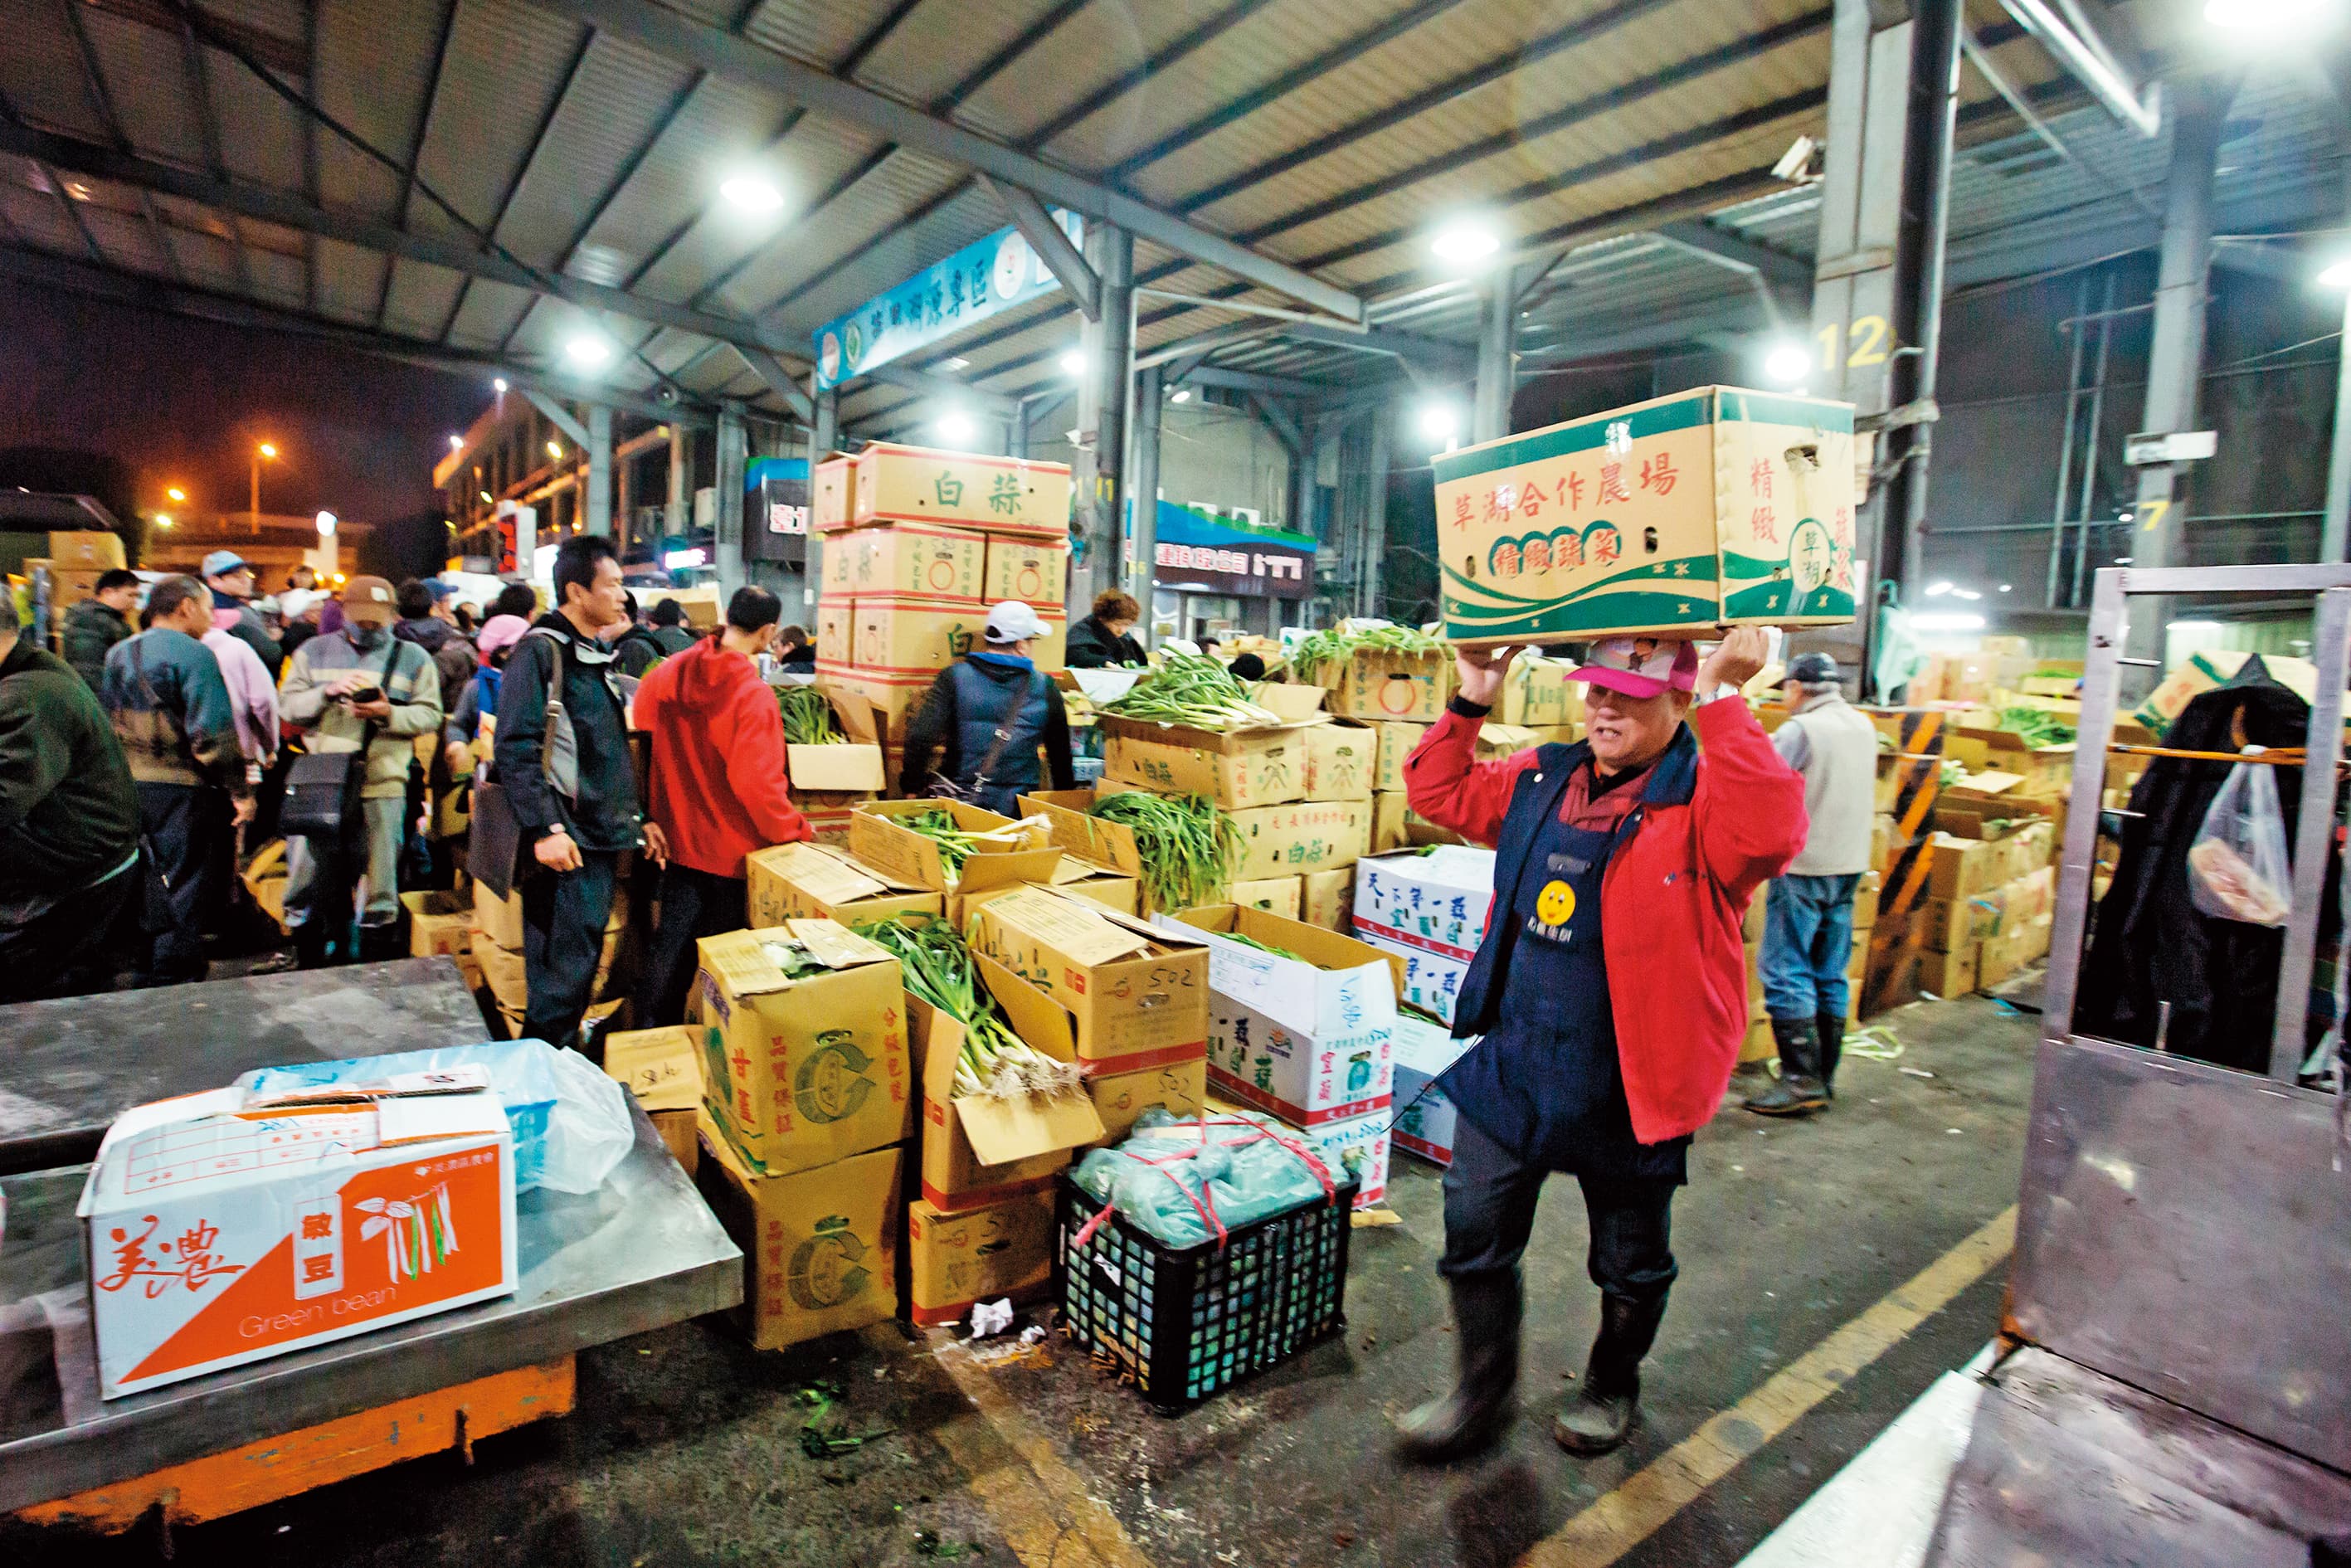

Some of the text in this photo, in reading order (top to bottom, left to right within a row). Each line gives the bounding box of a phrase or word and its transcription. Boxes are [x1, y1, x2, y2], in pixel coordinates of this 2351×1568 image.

[1818, 314, 1887, 371] 12
[933, 470, 1023, 515] 白蒜
[1452, 451, 1681, 533] 草湖合作農場
[1750, 457, 1779, 546] 精緻
[2139, 500, 2170, 532] 7
[1492, 527, 1621, 578] 精緻蔬菜
[300, 1211, 336, 1284] 敏豆
[239, 1287, 397, 1338] Green bean
